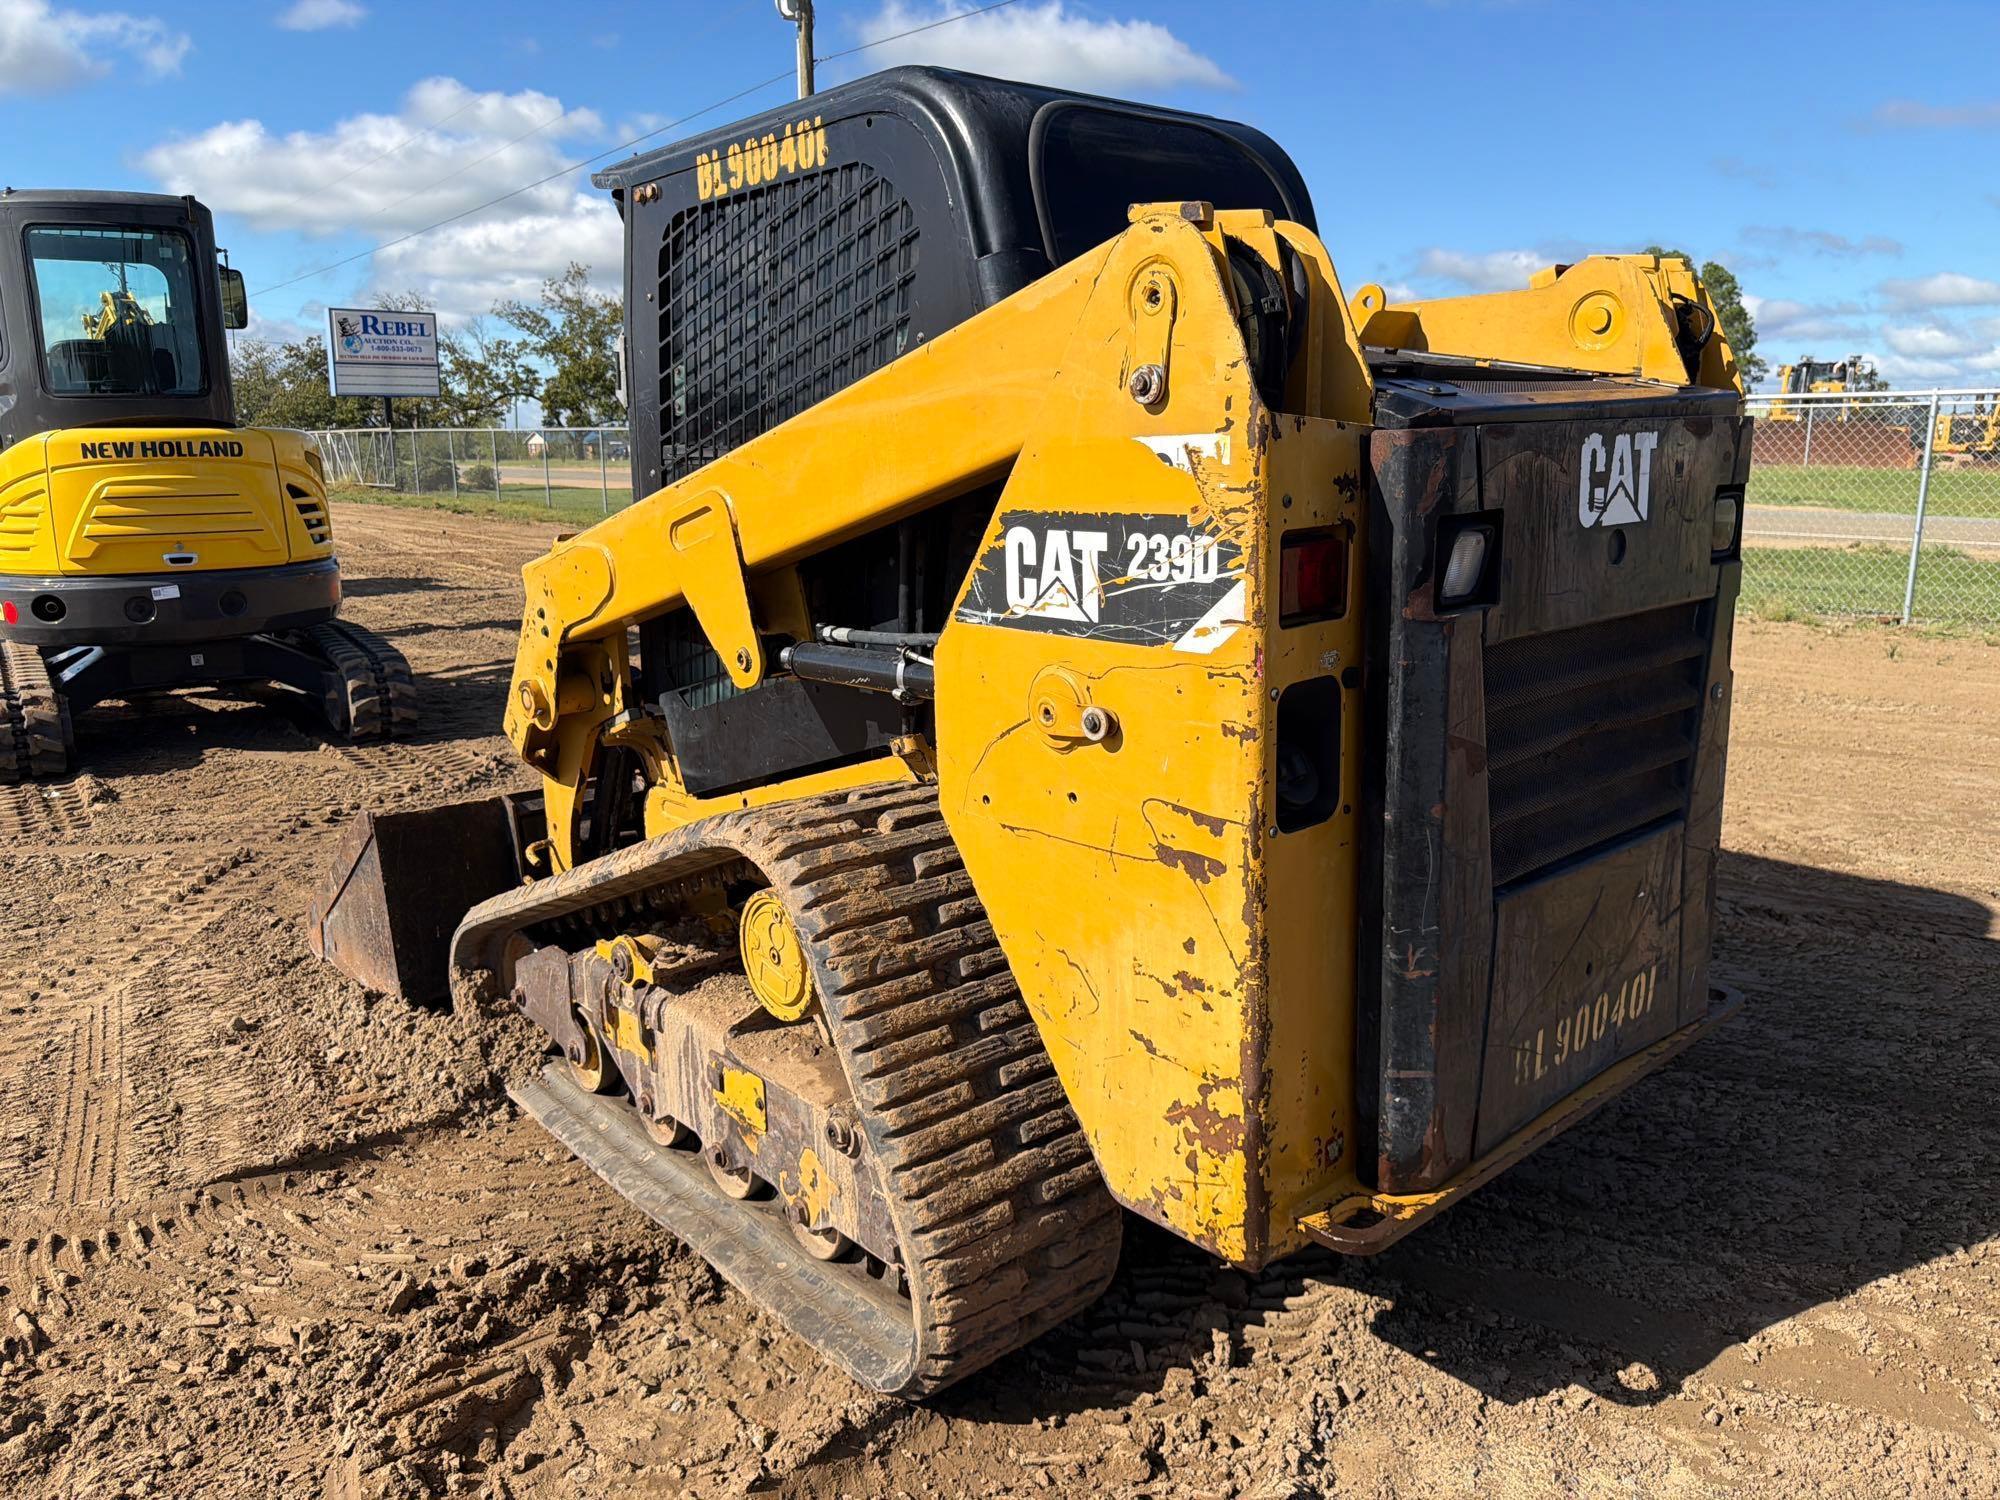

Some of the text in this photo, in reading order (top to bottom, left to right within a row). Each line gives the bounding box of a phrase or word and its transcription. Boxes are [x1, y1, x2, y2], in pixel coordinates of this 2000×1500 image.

[364, 337, 398, 345] AUCTION
[81, 441, 243, 459] NEW HOLLAND
[1579, 431, 1658, 528] CAT
[1005, 526, 1218, 623] CAT 239D
